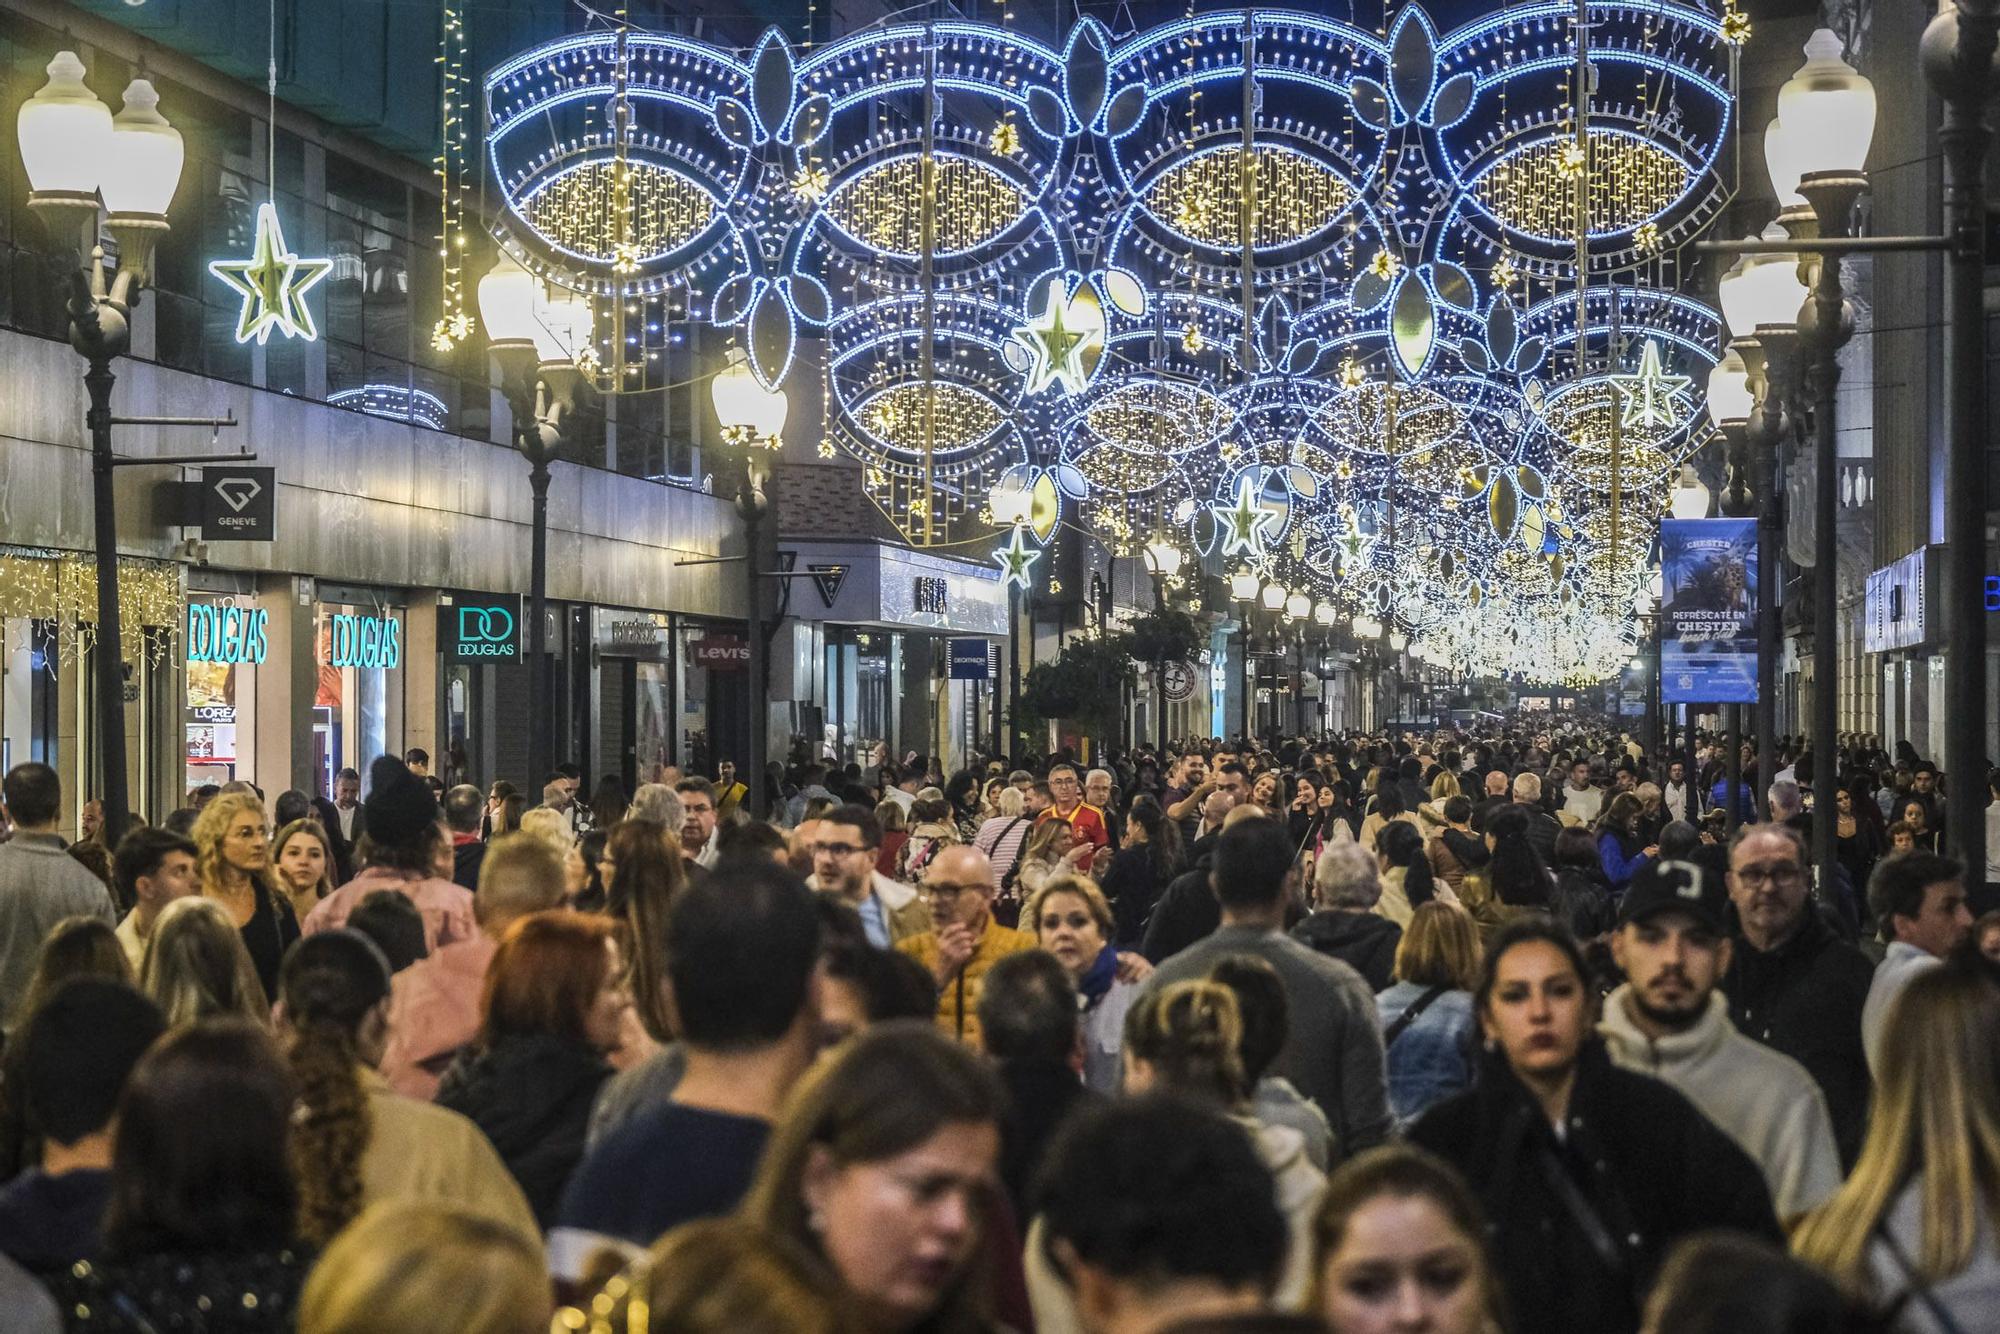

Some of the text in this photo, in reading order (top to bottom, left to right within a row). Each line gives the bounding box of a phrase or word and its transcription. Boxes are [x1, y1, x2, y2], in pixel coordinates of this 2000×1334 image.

[218, 517, 257, 526] GENEVE
[1686, 540, 1731, 549] CHESTER
[1672, 610, 1746, 620] REFRÉSCATE EN
[1676, 621, 1741, 632] CHESTER
[187, 604, 269, 665] DOUGLAS
[332, 614, 399, 669] DOUGLAS
[458, 643, 514, 656] DOUGLAS
